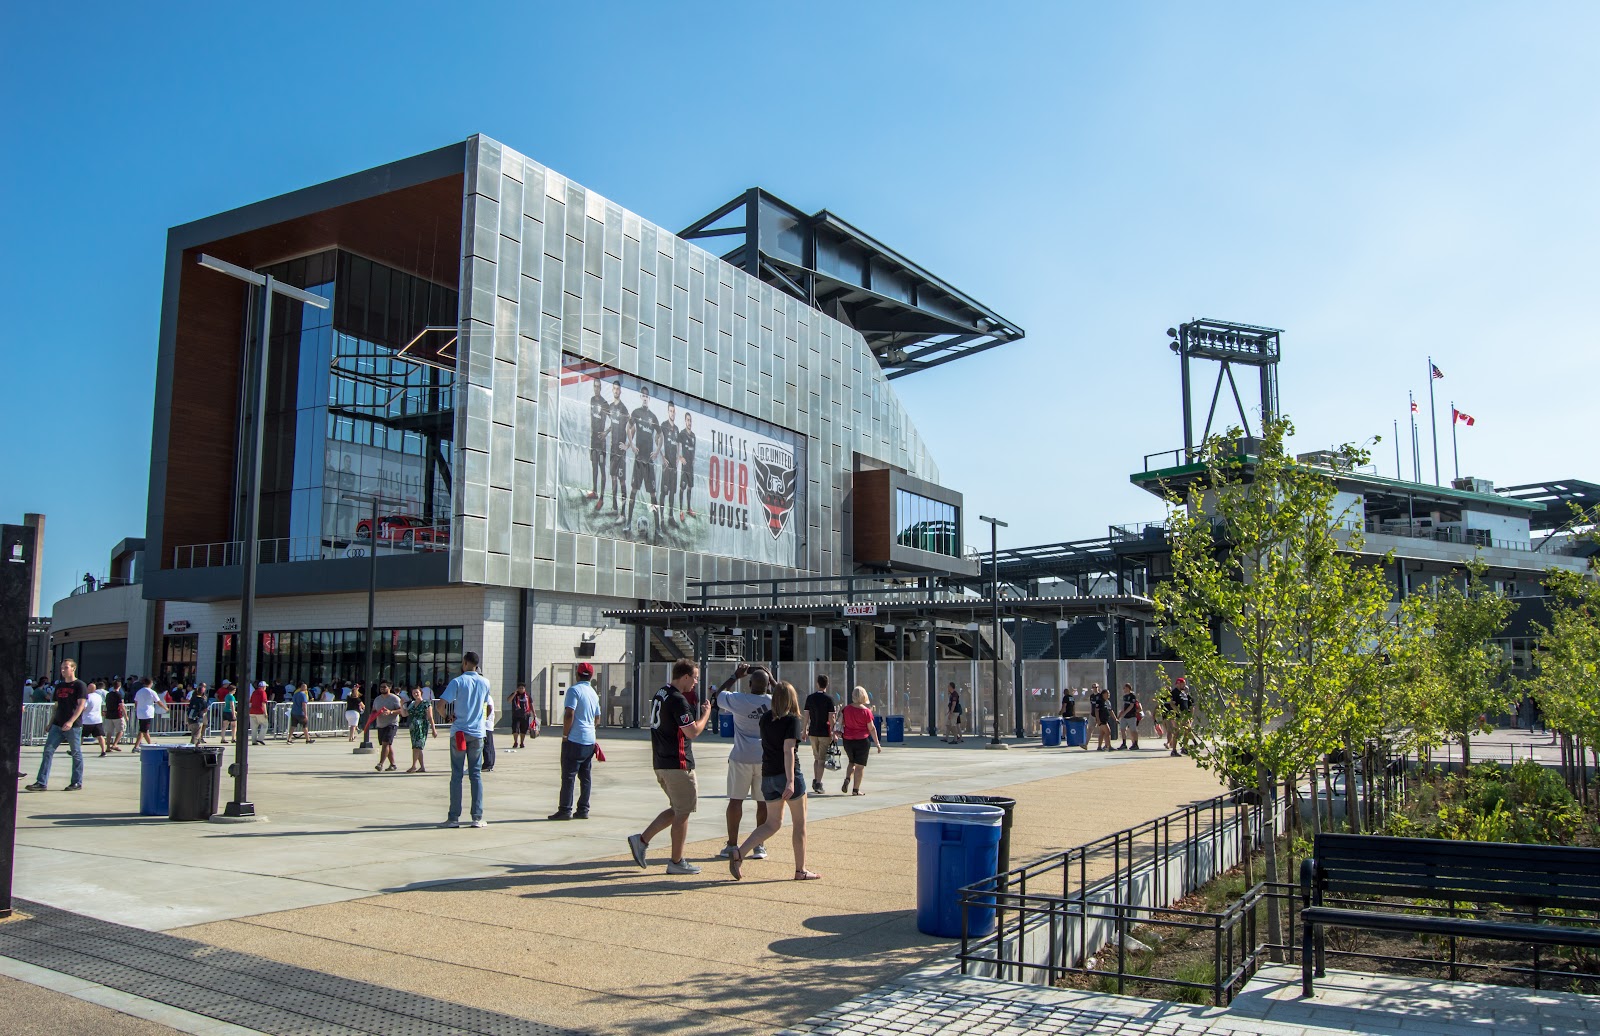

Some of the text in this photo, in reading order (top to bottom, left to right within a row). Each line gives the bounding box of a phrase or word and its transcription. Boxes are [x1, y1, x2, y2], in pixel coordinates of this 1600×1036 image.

[711, 430, 747, 462] THIS IS
[377, 468, 401, 491] THIS
[709, 455, 749, 506] OUR
[709, 502, 748, 530] HOUSE
[846, 606, 867, 615] GATE
[424, 641, 430, 649] 8
[454, 640, 459, 649] 9
